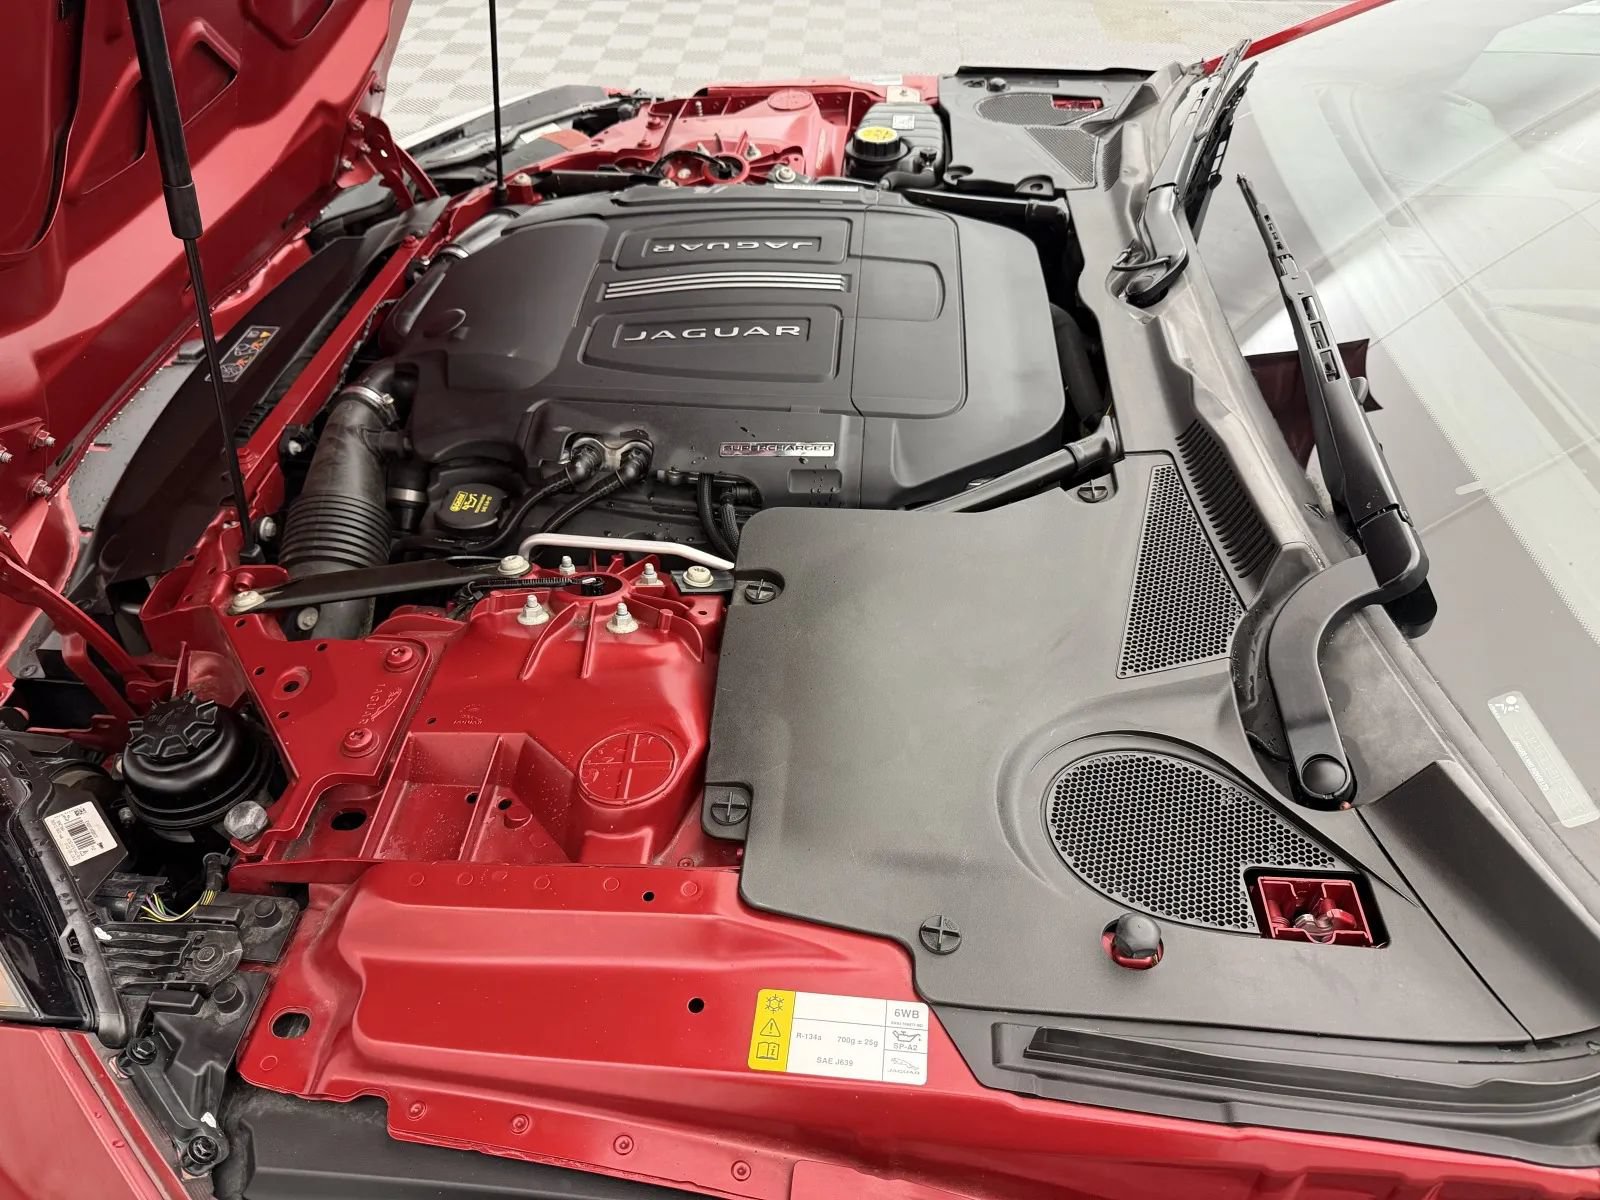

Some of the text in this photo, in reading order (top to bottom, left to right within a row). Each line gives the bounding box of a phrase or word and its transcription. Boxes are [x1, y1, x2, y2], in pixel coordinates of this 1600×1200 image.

[652, 240, 814, 254] JAGUAR
[623, 325, 801, 342] JAGUAR
[722, 443, 832, 452] SUPERCHARGED
[894, 1008, 920, 1019] 6WB
[796, 1032, 823, 1041] R-134a
[837, 1036, 856, 1046] 700g
[863, 1038, 879, 1048] 25g
[893, 1042, 918, 1051] SP-A2
[816, 1056, 854, 1066] SAE J639
